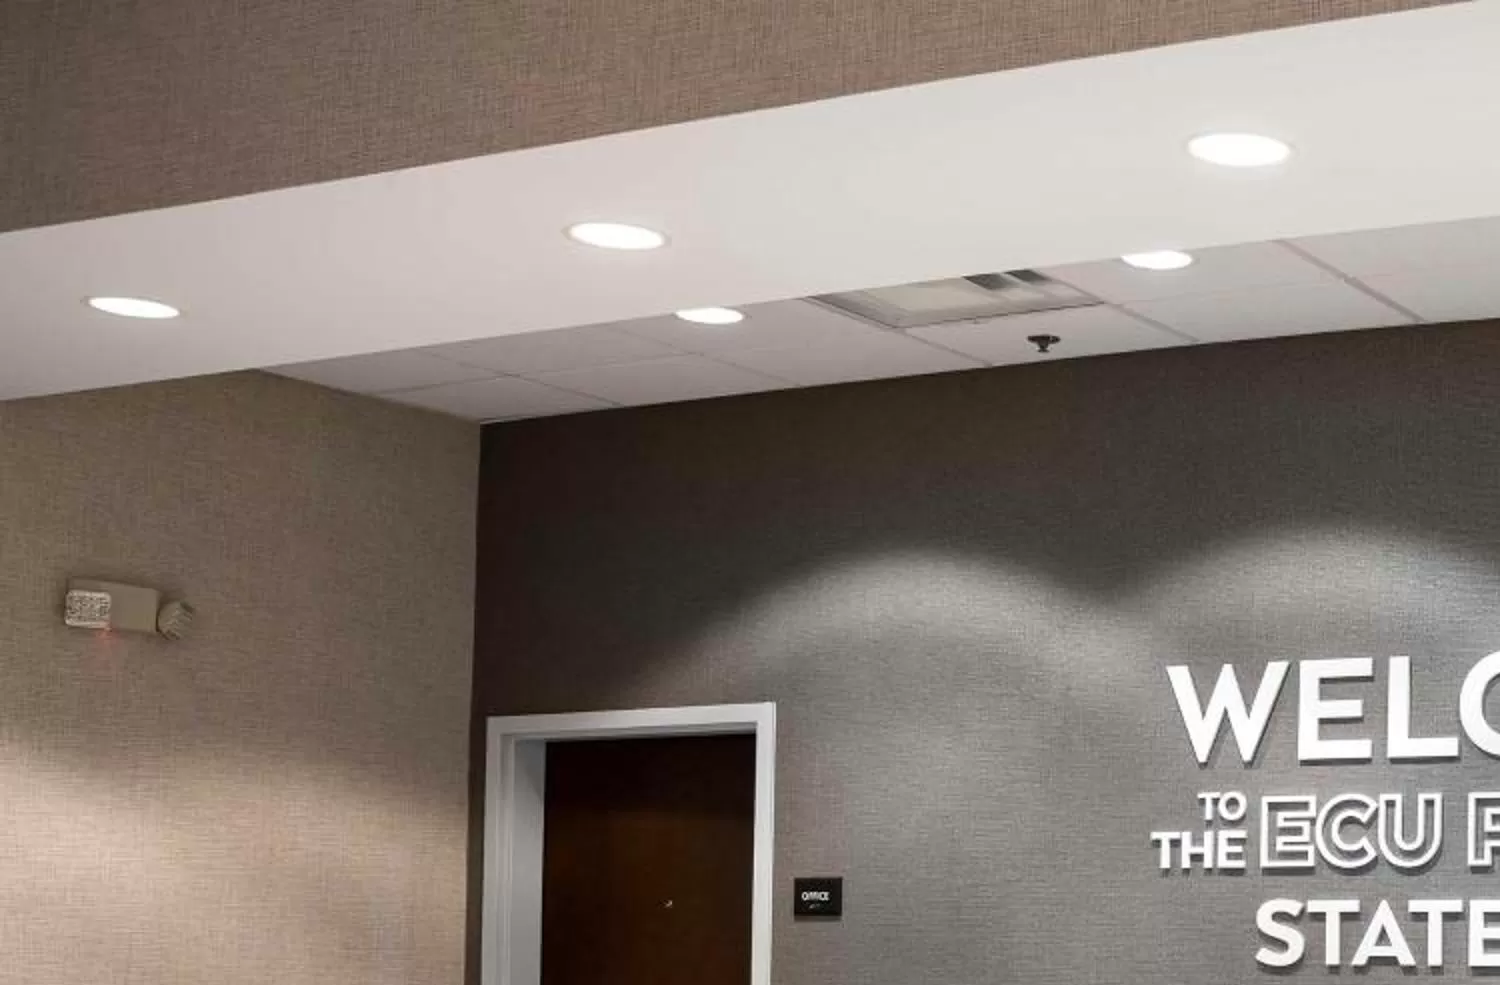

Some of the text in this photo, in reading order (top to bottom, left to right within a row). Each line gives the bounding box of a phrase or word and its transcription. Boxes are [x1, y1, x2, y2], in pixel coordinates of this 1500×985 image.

[1198, 791, 1246, 822] TO
[1150, 830, 1247, 870] THE
[1259, 793, 1442, 870] ECU
